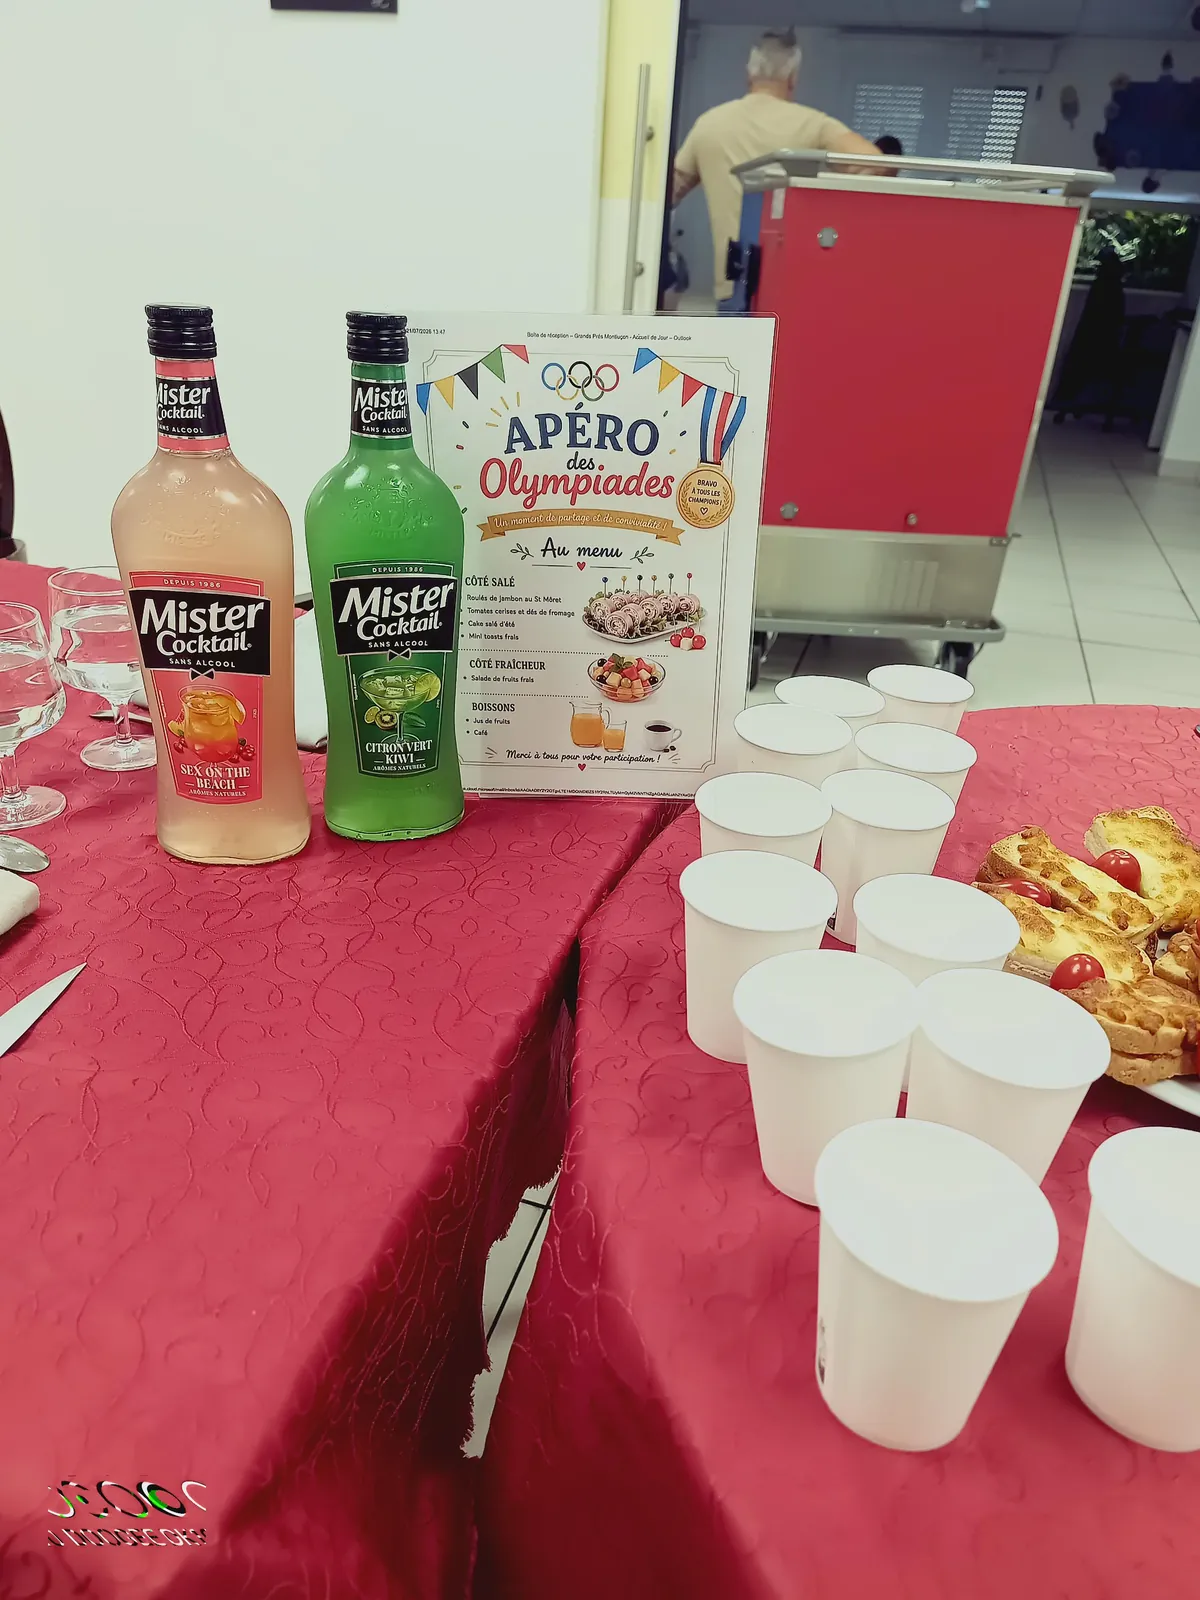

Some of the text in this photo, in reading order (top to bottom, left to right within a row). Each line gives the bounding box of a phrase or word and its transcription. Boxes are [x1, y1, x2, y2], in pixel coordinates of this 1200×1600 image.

[172, 426, 204, 434] ALCOOL
[362, 425, 408, 434] SANS ALCOOL
[504, 401, 660, 456] APÉRO
[566, 451, 596, 470] des
[480, 457, 675, 510] Olympiades
[697, 479, 718, 487] BRAVO
[696, 488, 710, 496] TOUS
[688, 496, 720, 506] CHAMPIONS
[493, 517, 508, 528] Un
[510, 514, 544, 526] moment
[545, 512, 556, 522] de
[558, 512, 590, 526] partage
[592, 513, 601, 522] et
[602, 513, 614, 523] de
[615, 516, 661, 530] convivialité
[541, 536, 622, 558] Au menu
[164, 578, 195, 586] DEPUIS
[465, 574, 516, 588] CÔTÉ SALÉ
[338, 582, 454, 624] Mister
[466, 594, 488, 602] Roulés
[489, 594, 498, 602] de
[542, 596, 562, 604] Môret
[140, 598, 264, 634] Mister
[548, 609, 575, 618] fromage
[500, 620, 516, 628] d'été
[468, 632, 482, 640] Mini
[169, 657, 236, 668] SANS ALCOOL
[469, 658, 546, 670] CÔTÉ FRAÎCHEUR
[471, 674, 492, 682] Salade
[472, 702, 516, 712] BOISSONS
[366, 740, 432, 754] CITRON VERT
[385, 753, 414, 764] KIWI
[506, 749, 532, 759] Merci
[534, 751, 540, 759] à
[542, 752, 558, 760] tous
[560, 753, 580, 762] pour
[582, 752, 602, 761] votre
[604, 753, 655, 764] participation
[180, 764, 250, 778] SEX ON THE
[398, 763, 426, 771] NATURELS
[196, 777, 236, 790] BEACH
